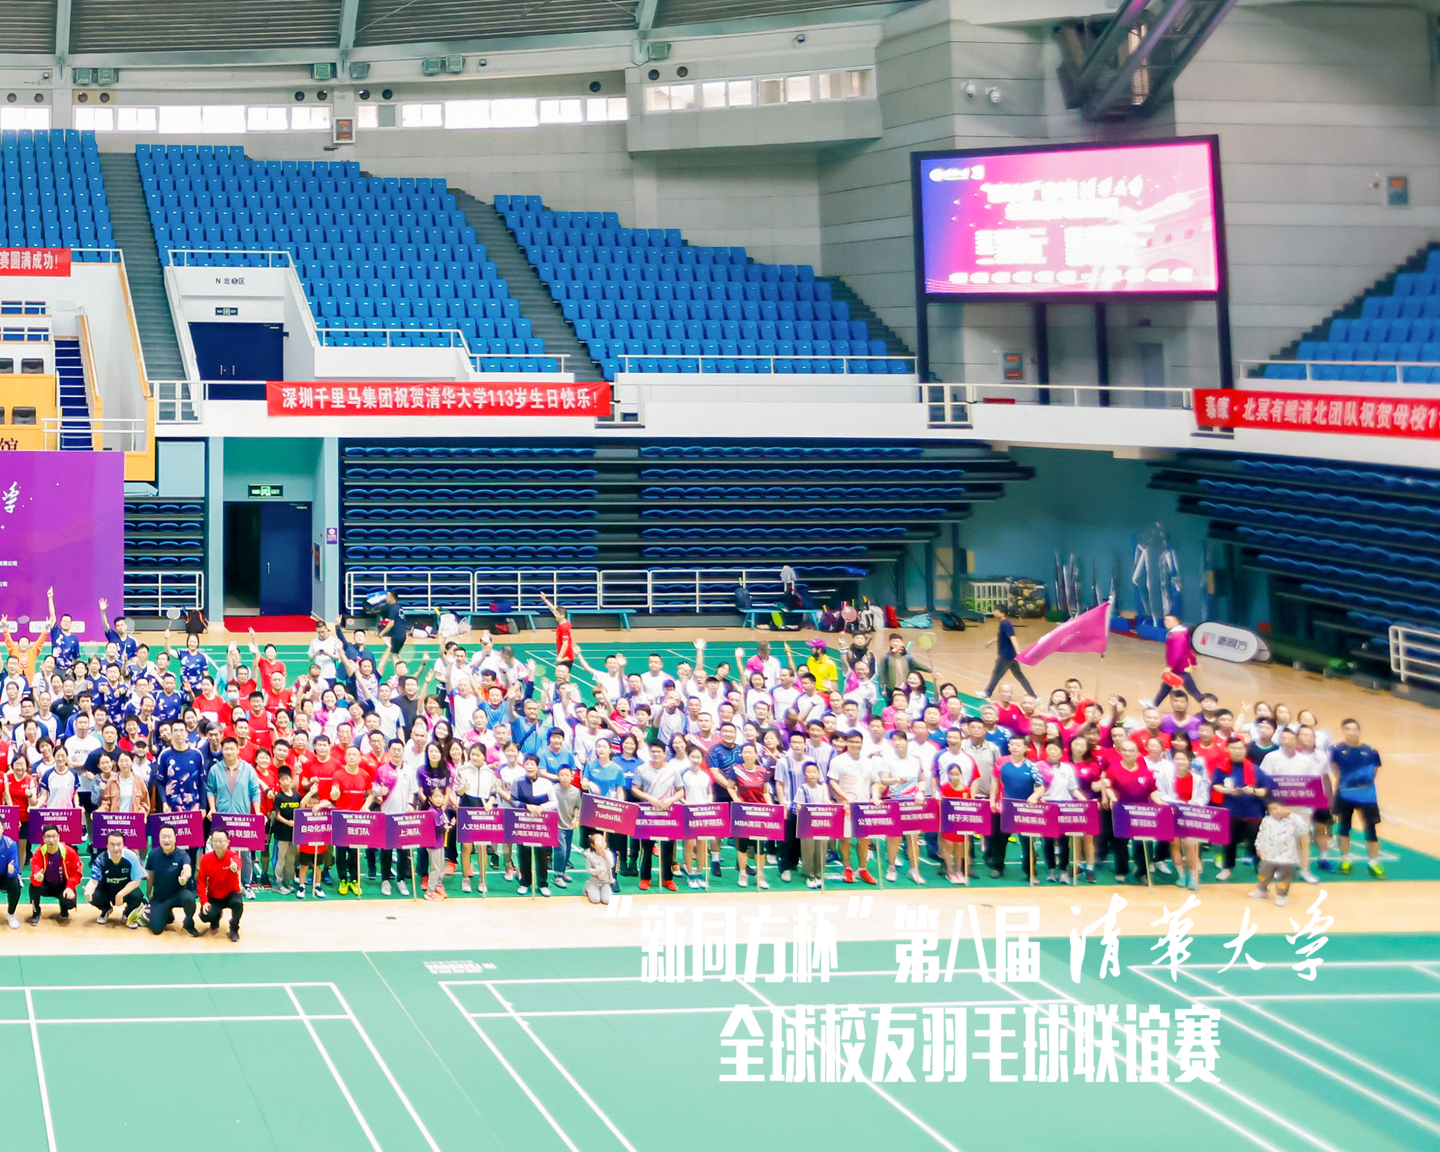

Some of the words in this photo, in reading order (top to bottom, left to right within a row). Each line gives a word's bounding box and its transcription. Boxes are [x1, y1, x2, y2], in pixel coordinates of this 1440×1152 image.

[1217, 635, 1248, 652] 新同方
[300, 824, 333, 834] 自动化系队
[347, 827, 371, 837] 我们队
[398, 827, 421, 837] 上海队
